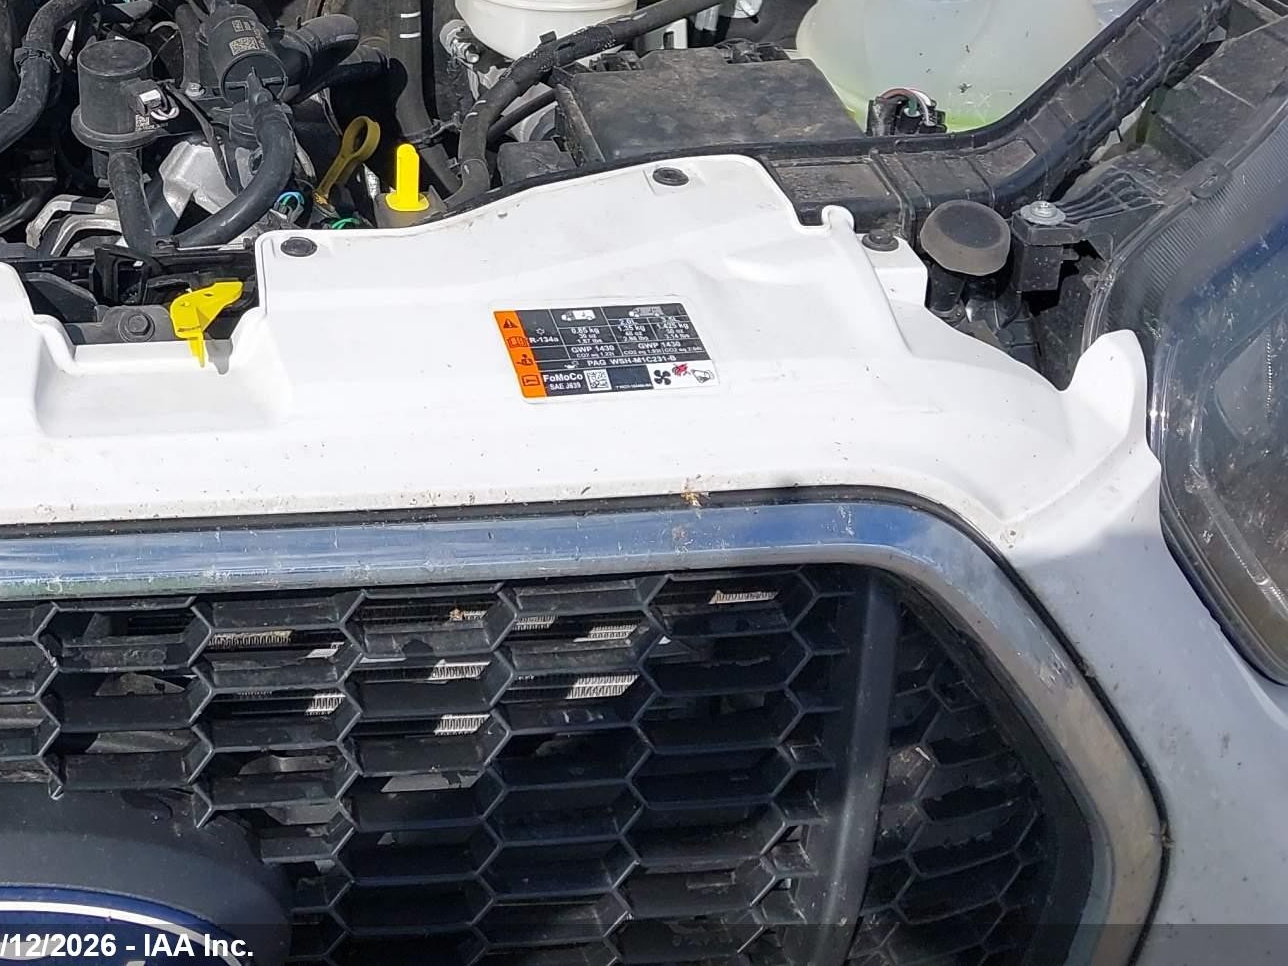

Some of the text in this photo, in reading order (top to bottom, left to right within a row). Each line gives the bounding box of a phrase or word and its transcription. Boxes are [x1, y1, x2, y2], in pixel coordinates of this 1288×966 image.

[529, 336, 559, 344] R-134a
[609, 355, 677, 365] WSH-M1C231-B
[542, 373, 583, 383] FoMoCo
